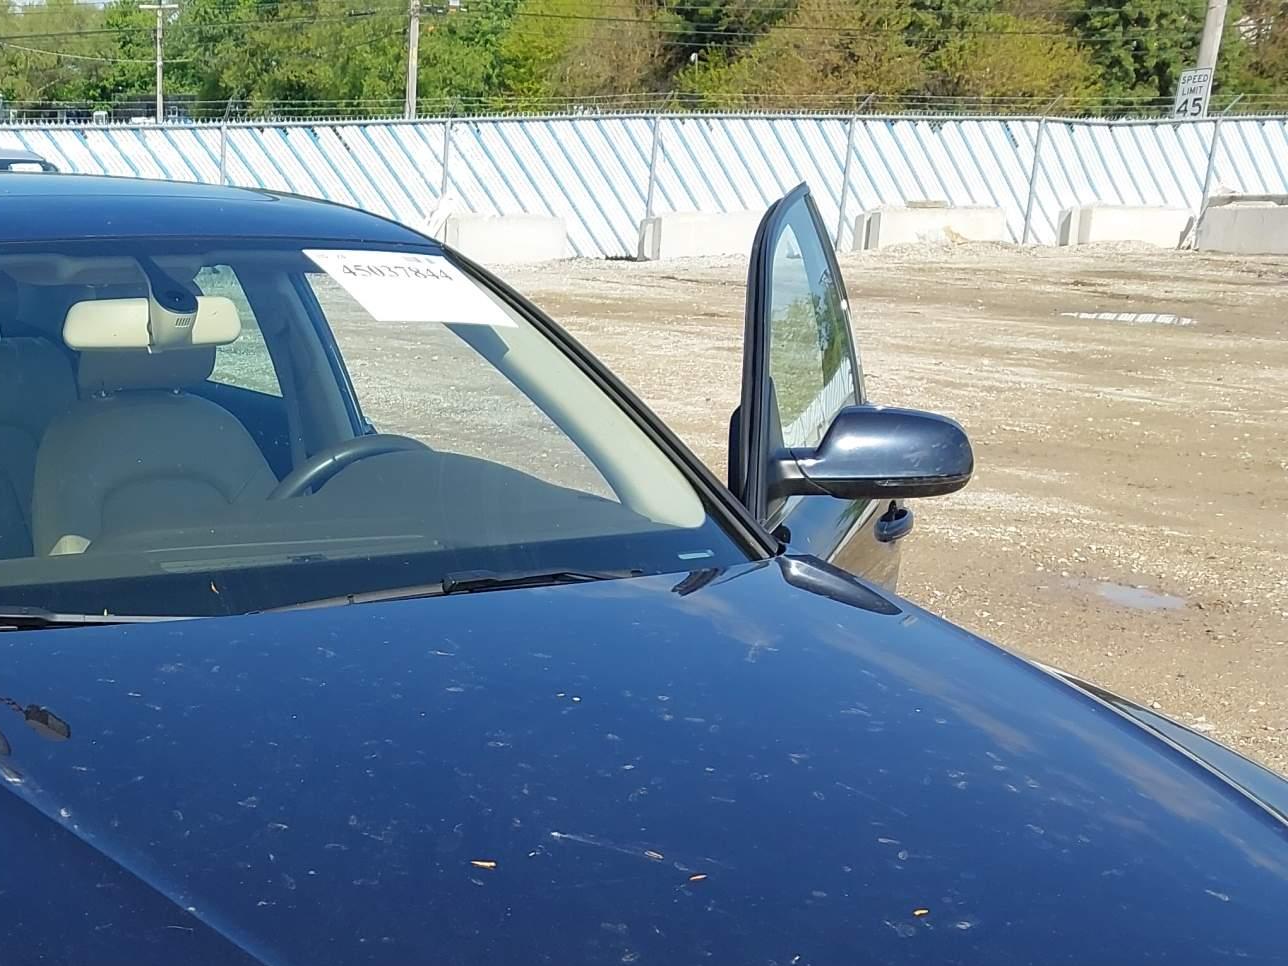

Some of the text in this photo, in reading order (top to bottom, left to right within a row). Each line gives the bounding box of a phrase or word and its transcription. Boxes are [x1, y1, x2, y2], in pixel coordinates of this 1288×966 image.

[1181, 75, 1209, 85] SPEED
[1181, 85, 1204, 96] LIMIT
[1176, 97, 1203, 117] 45
[342, 263, 454, 282] 45037844
